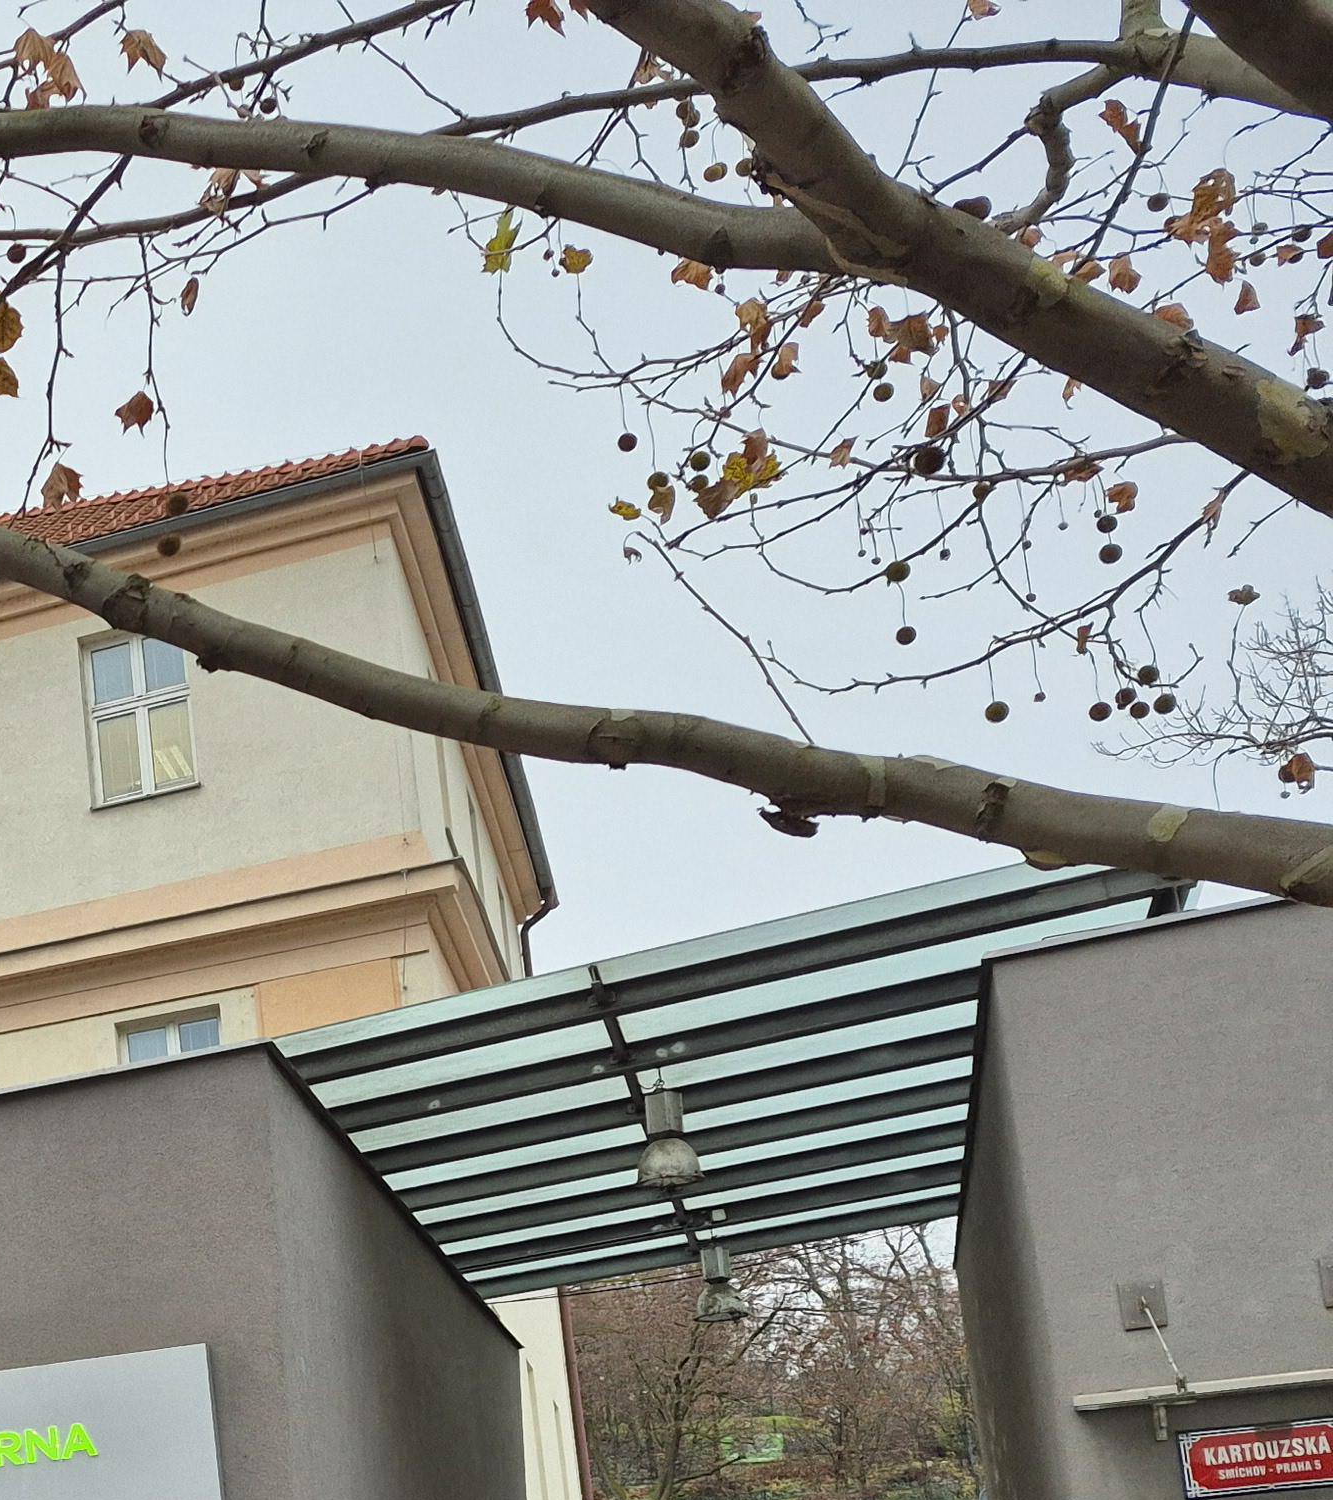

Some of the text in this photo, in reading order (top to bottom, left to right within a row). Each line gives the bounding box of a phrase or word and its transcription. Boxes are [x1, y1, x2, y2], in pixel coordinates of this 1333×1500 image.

[1203, 1431, 1332, 1466] KARTOUZSKÁ
[1218, 1466, 1266, 1480] SMÍCHOV
[1276, 1460, 1313, 1474] PRAHA
[1313, 1460, 1322, 1470] 5
